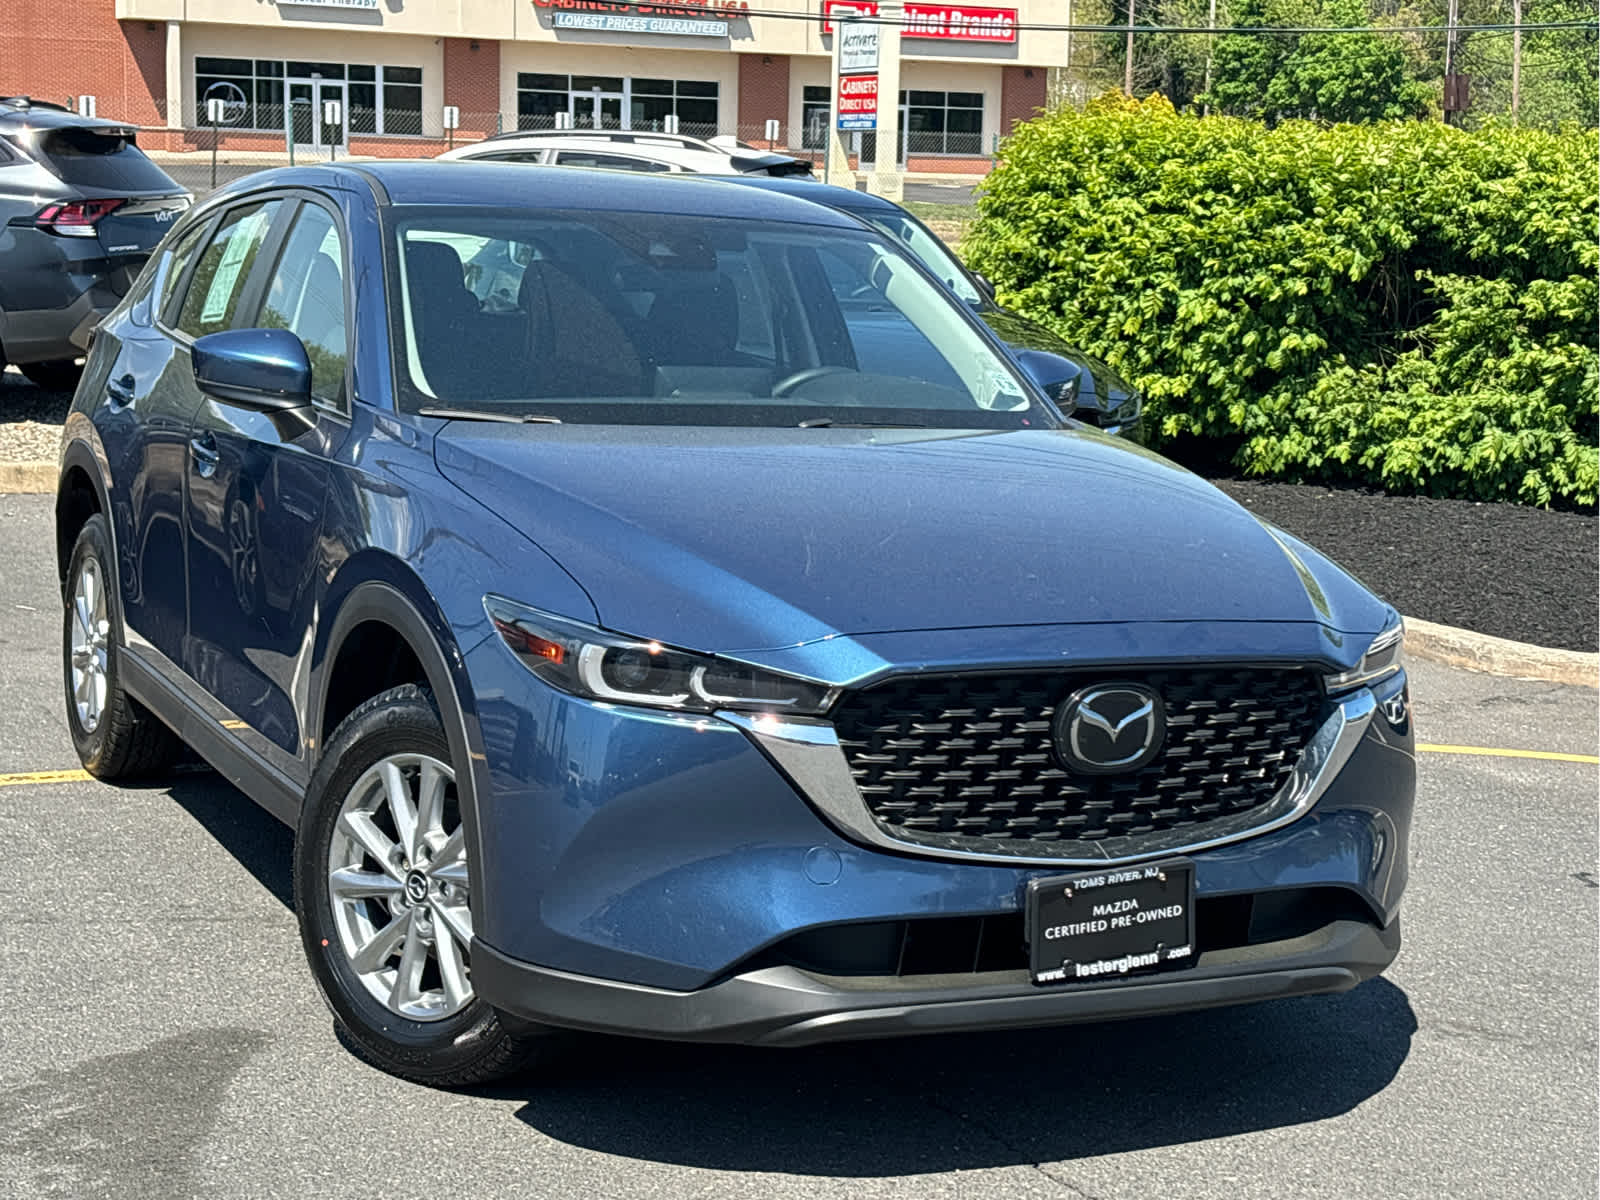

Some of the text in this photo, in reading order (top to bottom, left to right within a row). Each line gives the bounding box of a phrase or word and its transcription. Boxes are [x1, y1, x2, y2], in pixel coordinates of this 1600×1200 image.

[558, 14, 725, 34] LOWEST PRICES GUARANTEED
[949, 11, 1013, 37] Brands
[840, 78, 877, 95] CABINETS
[840, 97, 876, 110] DIRECT USA
[154, 211, 173, 223] KIA
[1073, 876, 1105, 890] TOMS
[1144, 867, 1159, 879] NJ
[1092, 899, 1139, 917] MAZDA
[1045, 905, 1183, 940] CERTIFIED PRE-OWNED
[1076, 951, 1158, 977] lesterglenn
